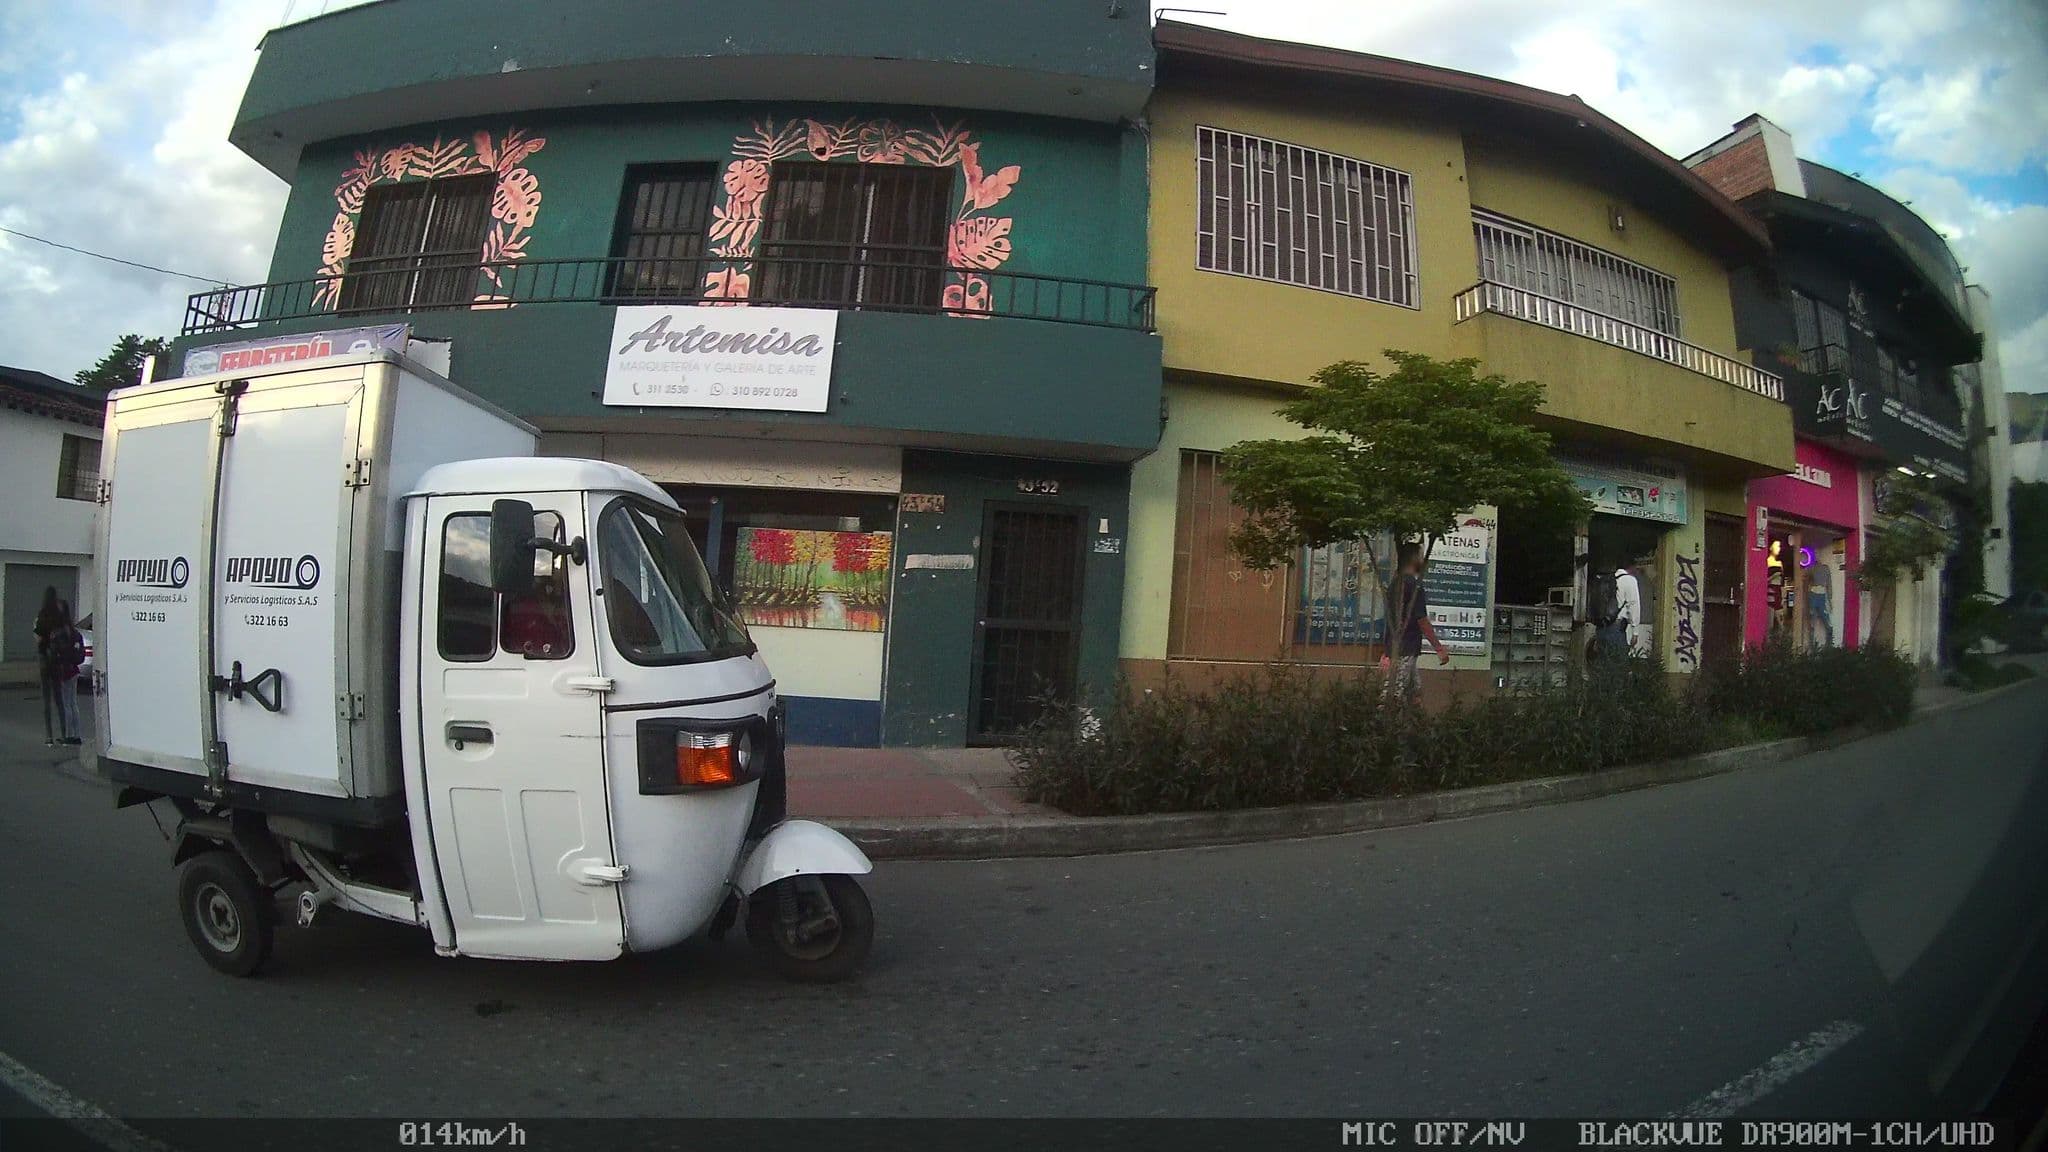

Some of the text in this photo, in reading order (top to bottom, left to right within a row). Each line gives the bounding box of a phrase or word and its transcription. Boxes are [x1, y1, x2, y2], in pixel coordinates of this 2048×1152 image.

[618, 314, 824, 357] Artemisa
[619, 360, 817, 377] MARQUETERÍA Y GALERÍA DE ARTE
[646, 384, 662, 395] 311
[731, 385, 749, 396] 310
[752, 386, 771, 397] 892
[773, 387, 798, 398] 0728
[116, 559, 169, 583] APOYO
[225, 557, 293, 583] APOYO
[119, 592, 144, 603] Servicios
[230, 595, 260, 605] Servicios
[135, 611, 166, 623] 322 16 63
[249, 615, 289, 627] 322 16 63
